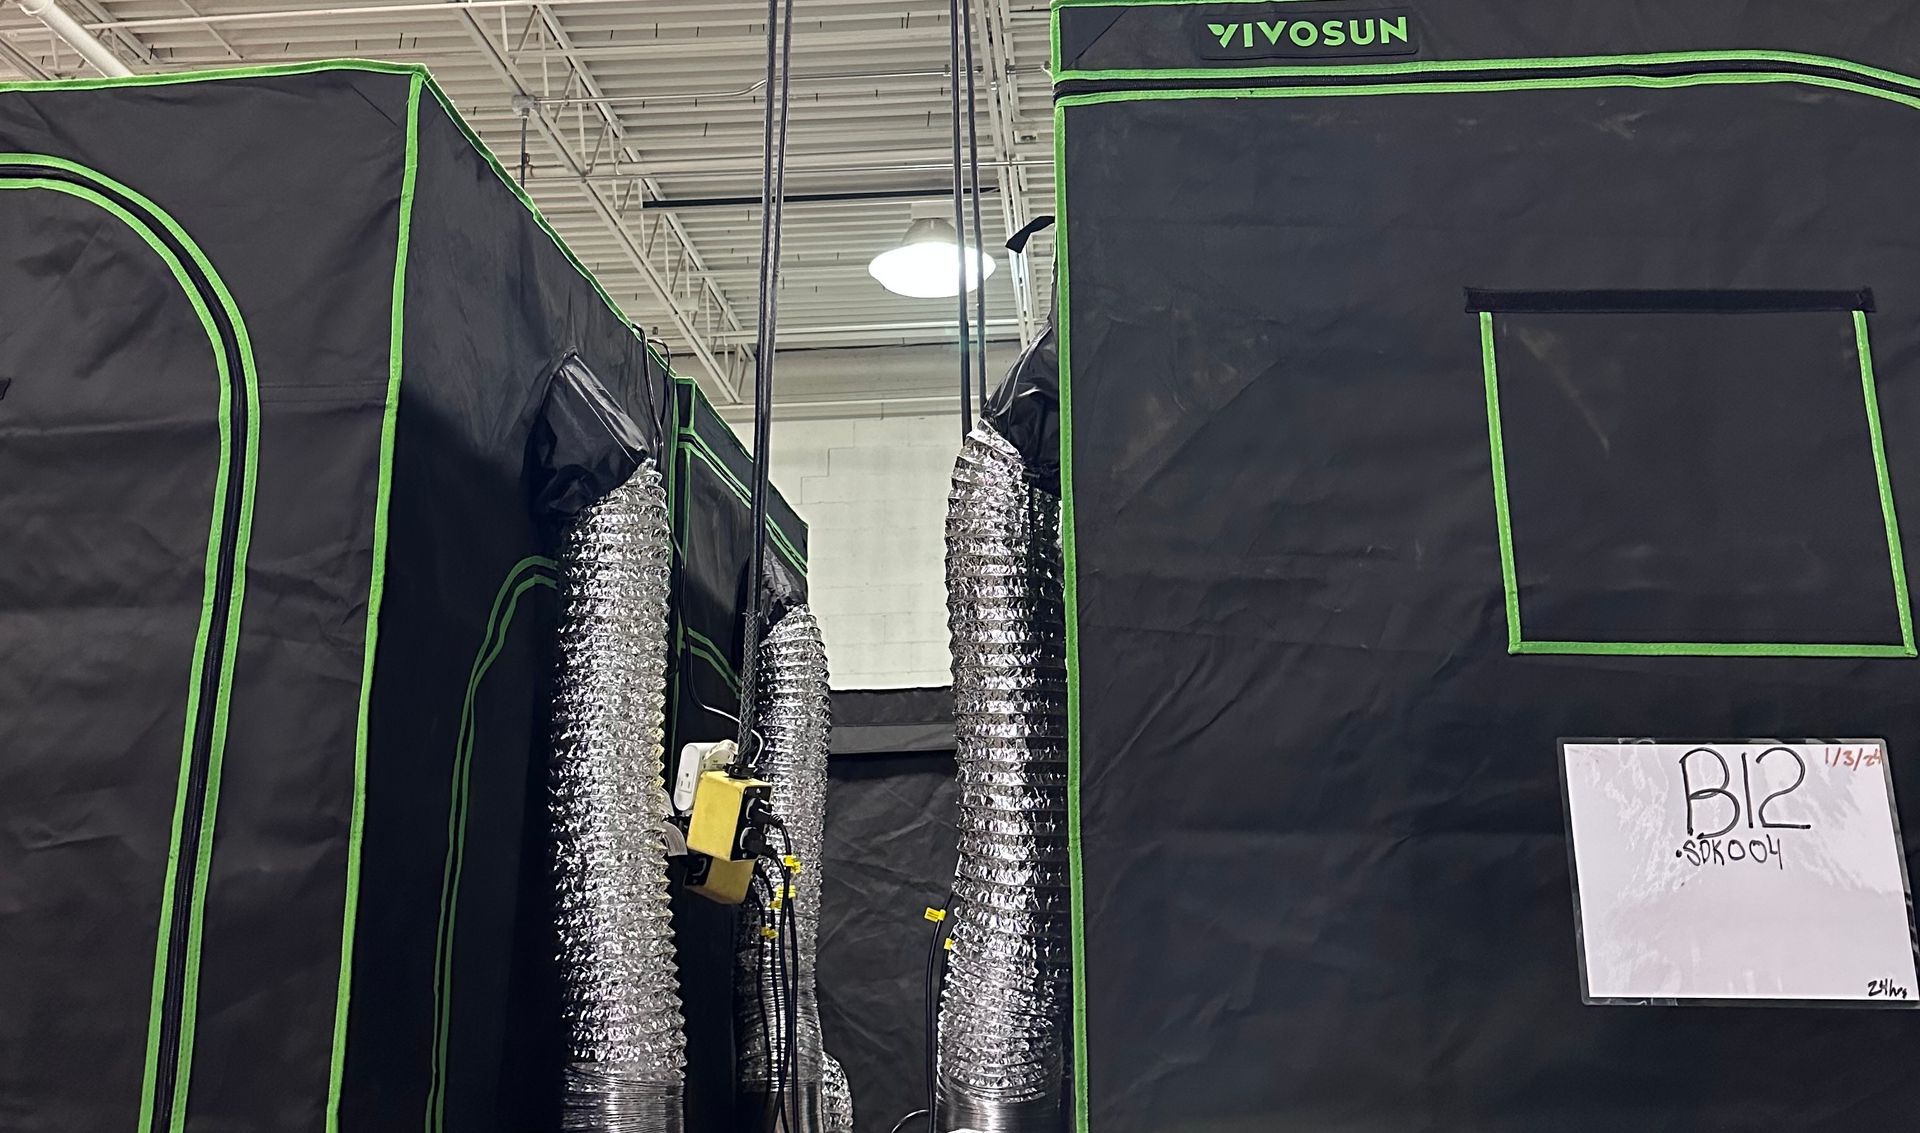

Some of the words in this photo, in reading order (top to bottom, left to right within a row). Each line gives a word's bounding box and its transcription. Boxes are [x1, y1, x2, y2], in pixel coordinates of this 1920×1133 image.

[1207, 16, 1408, 49] VIVOSUN
[1825, 747, 1883, 771] 1/3/24
[1679, 747, 1812, 840] B12
